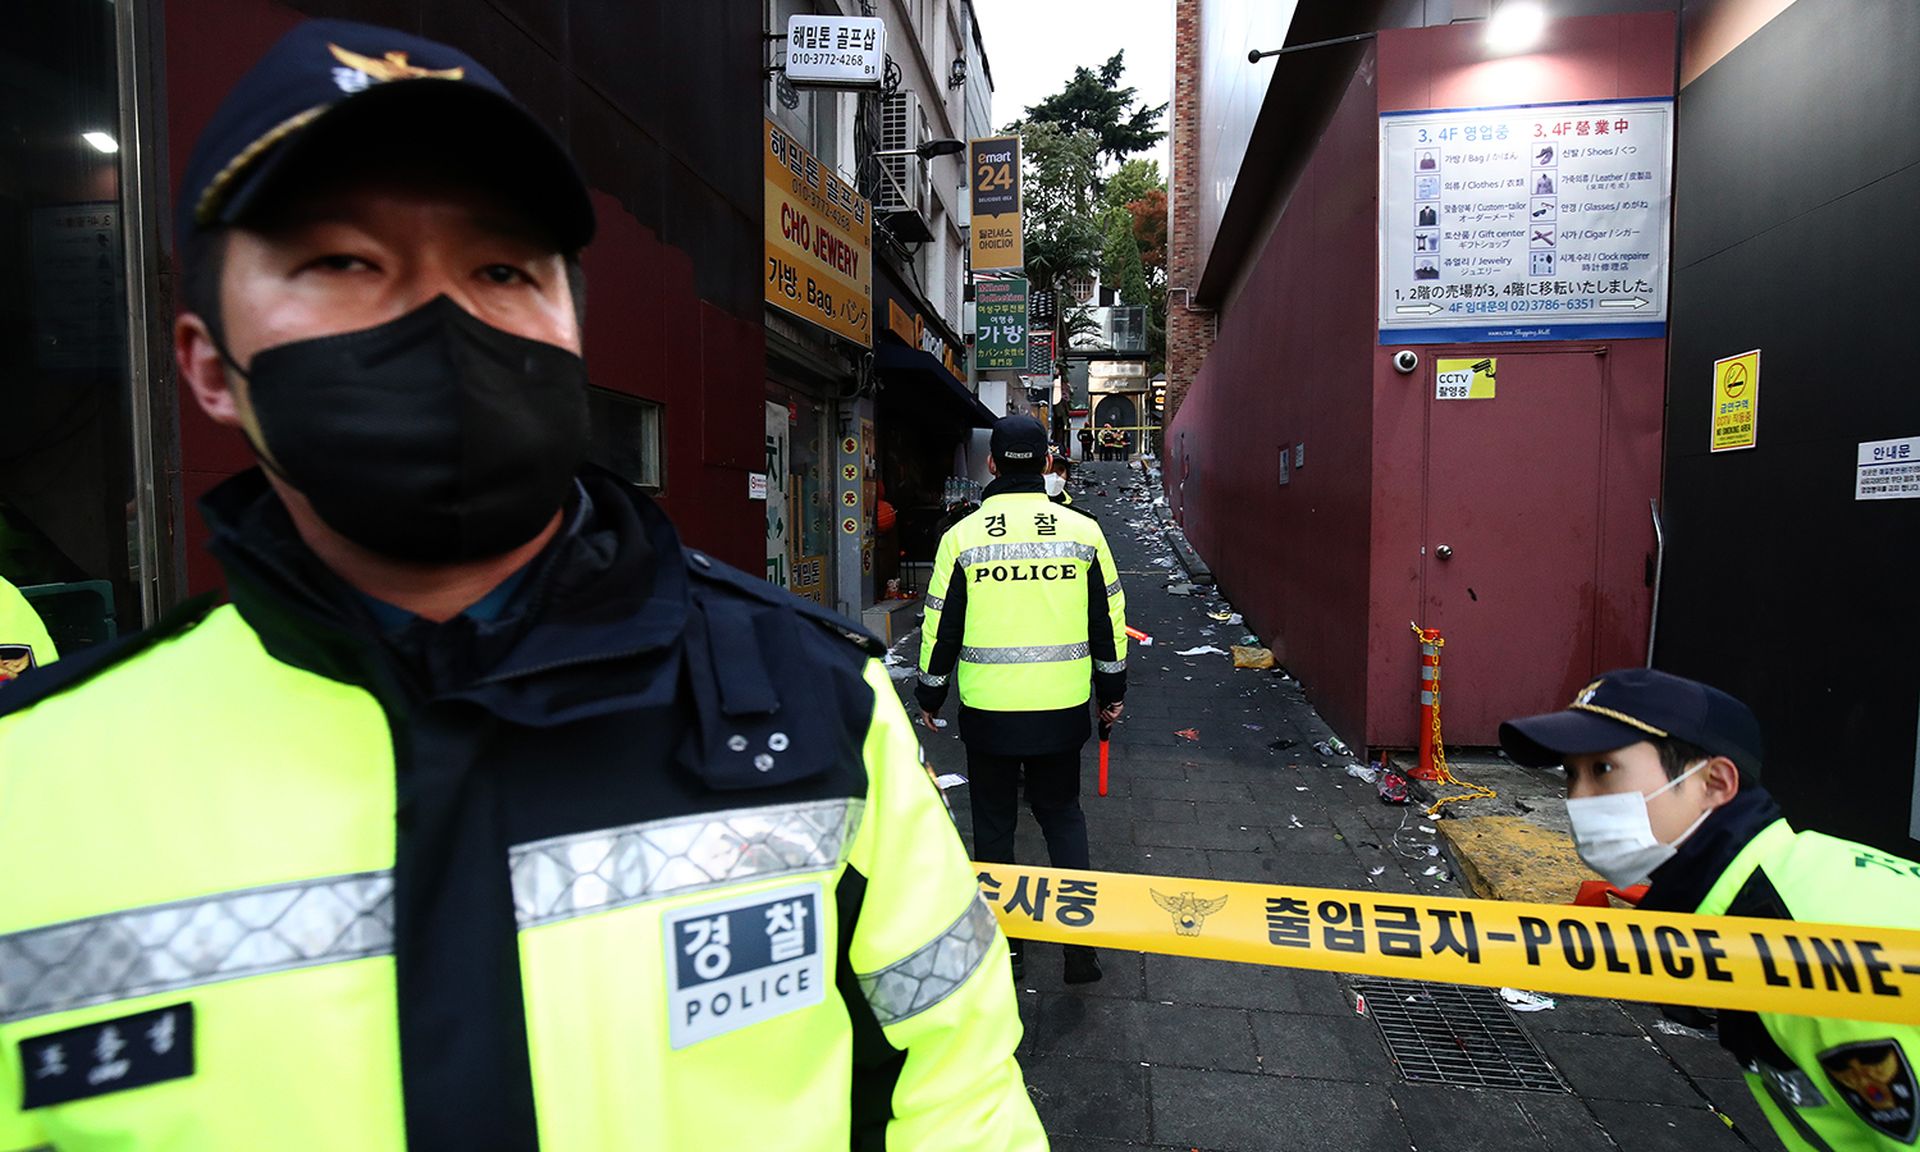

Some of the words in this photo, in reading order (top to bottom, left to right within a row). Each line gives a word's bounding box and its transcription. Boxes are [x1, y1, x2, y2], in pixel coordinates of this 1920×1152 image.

[793, 26, 830, 49] 해밀톤
[837, 27, 876, 51] 골프샵
[792, 53, 863, 66] 010-3772-4268
[1439, 127, 1458, 141] 4F
[1464, 124, 1510, 142] 영업중
[1552, 121, 1572, 136] 4F
[978, 151, 1011, 164] emart
[1587, 147, 1613, 156] Shoes
[1621, 146, 1638, 154] くつ
[1468, 153, 1485, 164] Bag
[770, 127, 819, 191] 해밀톤
[826, 172, 865, 226] 골프샵
[978, 163, 1014, 191] 24
[1595, 173, 1624, 182] Leather
[1467, 179, 1499, 190] Clothes
[1584, 202, 1615, 212] Glasses
[1478, 230, 1495, 239] Gift
[1496, 229, 1526, 238] center
[1584, 230, 1607, 240] Cigar
[781, 202, 810, 252] CHO
[813, 225, 858, 281] JEWERY
[1478, 256, 1512, 266] Jewelry
[1598, 252, 1618, 261] Clock
[807, 277, 836, 319] Bag,
[1449, 303, 1463, 312] 4F
[1466, 301, 1508, 313] 임대문의
[1512, 298, 1595, 313] 02)3786-6351
[979, 325, 1024, 343] 가방
[1439, 374, 1469, 384] CCTV
[1439, 386, 1468, 397] 촬영중
[1873, 444, 1911, 460] 안내문
[975, 564, 1077, 583] POLICE
[686, 968, 810, 1026] POLICE
